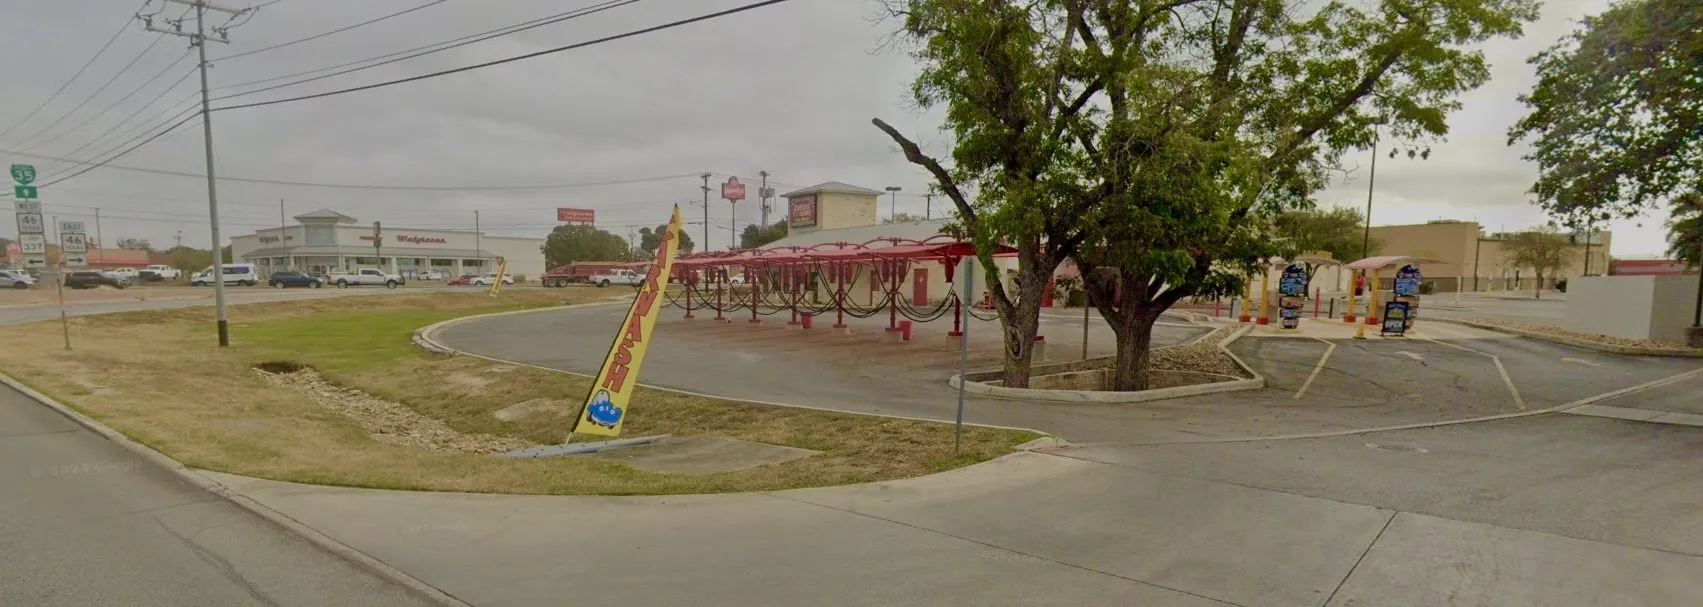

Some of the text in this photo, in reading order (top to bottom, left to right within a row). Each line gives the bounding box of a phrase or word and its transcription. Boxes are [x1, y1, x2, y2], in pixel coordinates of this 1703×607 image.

[15, 170, 34, 181] 35
[22, 216, 37, 224] 46
[66, 236, 82, 244] 46
[396, 234, 447, 244] Walgreens
[24, 243, 42, 251] 337
